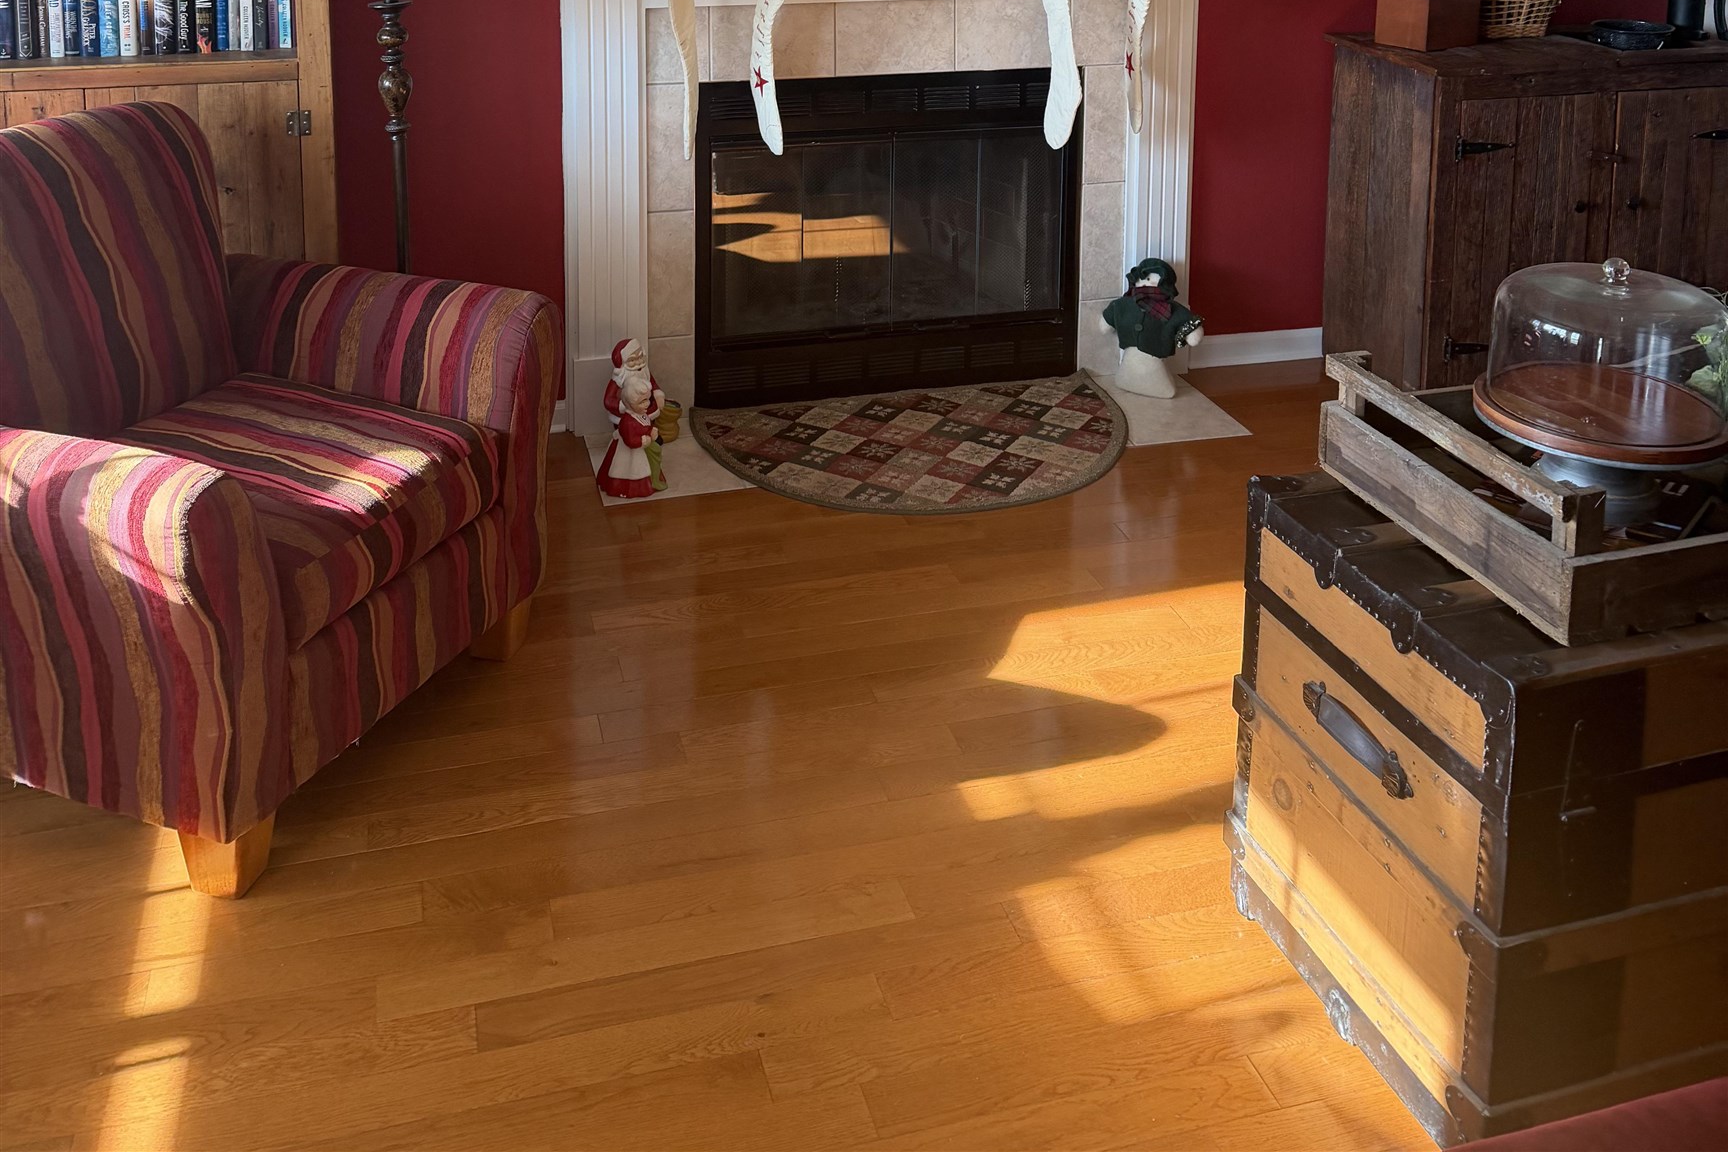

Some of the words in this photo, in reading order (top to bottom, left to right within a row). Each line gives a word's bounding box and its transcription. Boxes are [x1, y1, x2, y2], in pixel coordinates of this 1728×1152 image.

[122, 1, 130, 24] CROSS'S
[180, 12, 188, 28] Good
[256, 6, 265, 28] Verity
[179, 28, 189, 40] Guy
